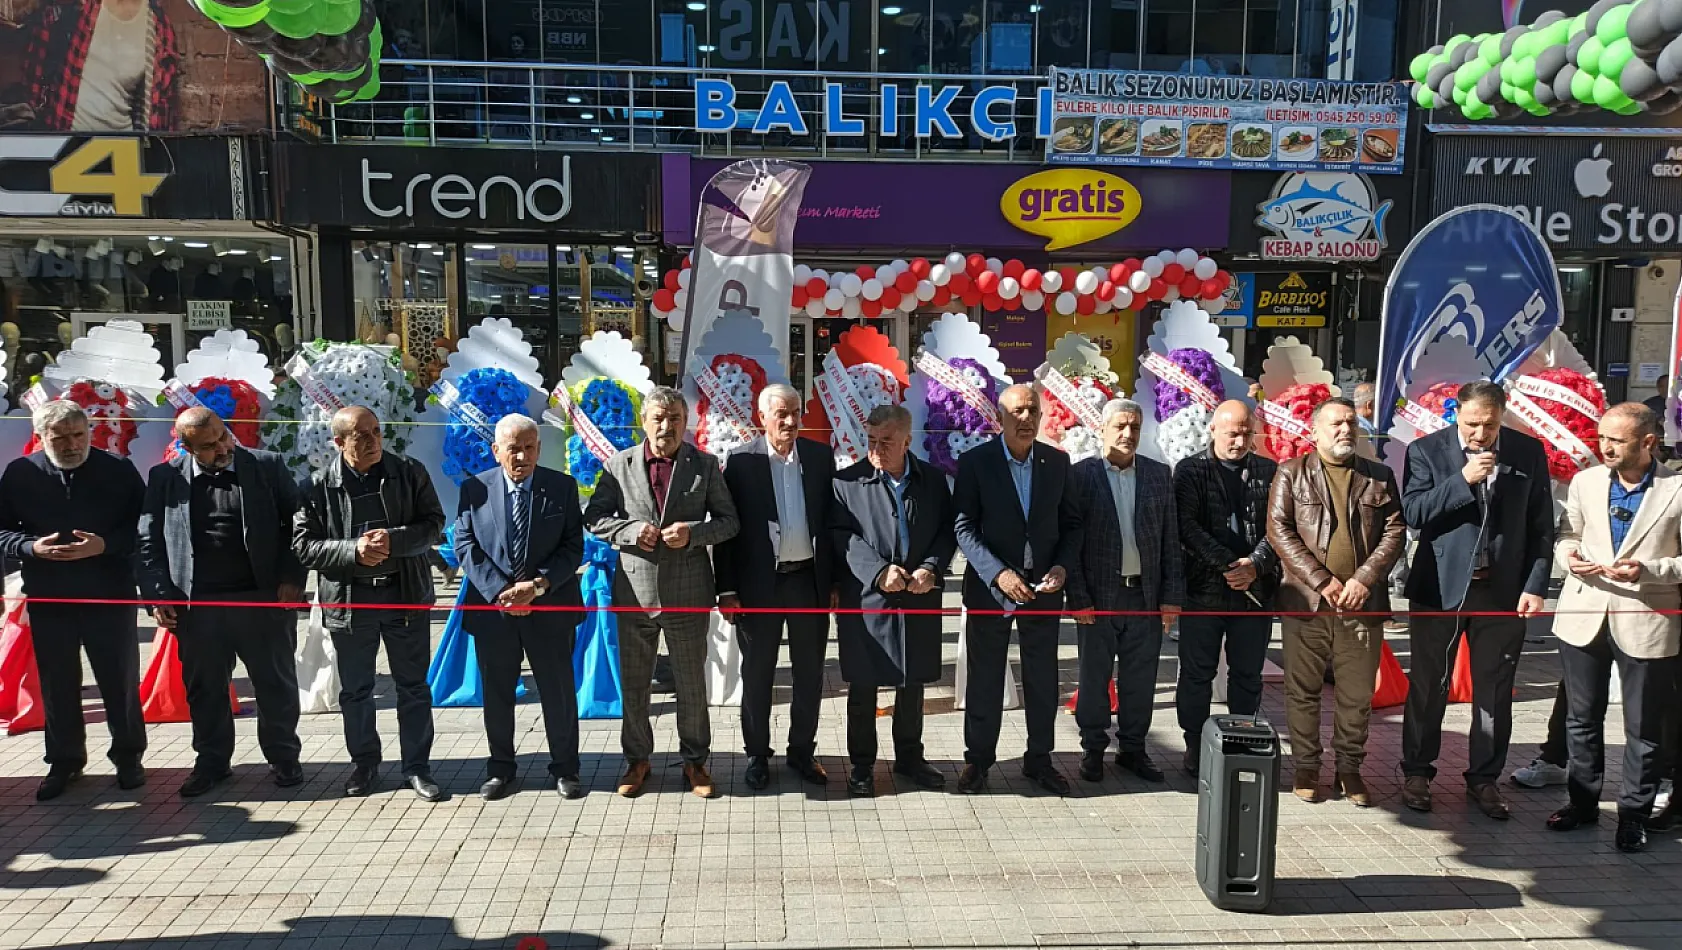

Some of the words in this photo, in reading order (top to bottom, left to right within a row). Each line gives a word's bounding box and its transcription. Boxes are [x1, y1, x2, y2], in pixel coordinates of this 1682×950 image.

[1056, 72, 1118, 97] BALIK
[1123, 74, 1254, 101] SEZONUMUZ
[1259, 80, 1402, 107] BAŞLAMIŞTIR.
[1056, 101, 1098, 113] EVLERE
[1100, 101, 1125, 114] KİLO
[1127, 101, 1144, 116] İLE
[1147, 103, 1179, 117] BALIK
[1316, 111, 1343, 123] 0545
[1345, 112, 1365, 123] 250
[1368, 112, 1382, 124] 59
[1384, 113, 1397, 124] 02
[1465, 156, 1537, 175] KVK
[361, 155, 572, 222] trend
[1019, 179, 1125, 221] gratis
[1296, 209, 1354, 228] BALIKÇILIK
[1597, 203, 1682, 244] Sto
[1313, 226, 1324, 237] &
[1265, 241, 1313, 257] KEBAP
[1317, 241, 1378, 257] SALONU
[1276, 317, 1296, 325] KAT
[1300, 317, 1307, 325] 2
